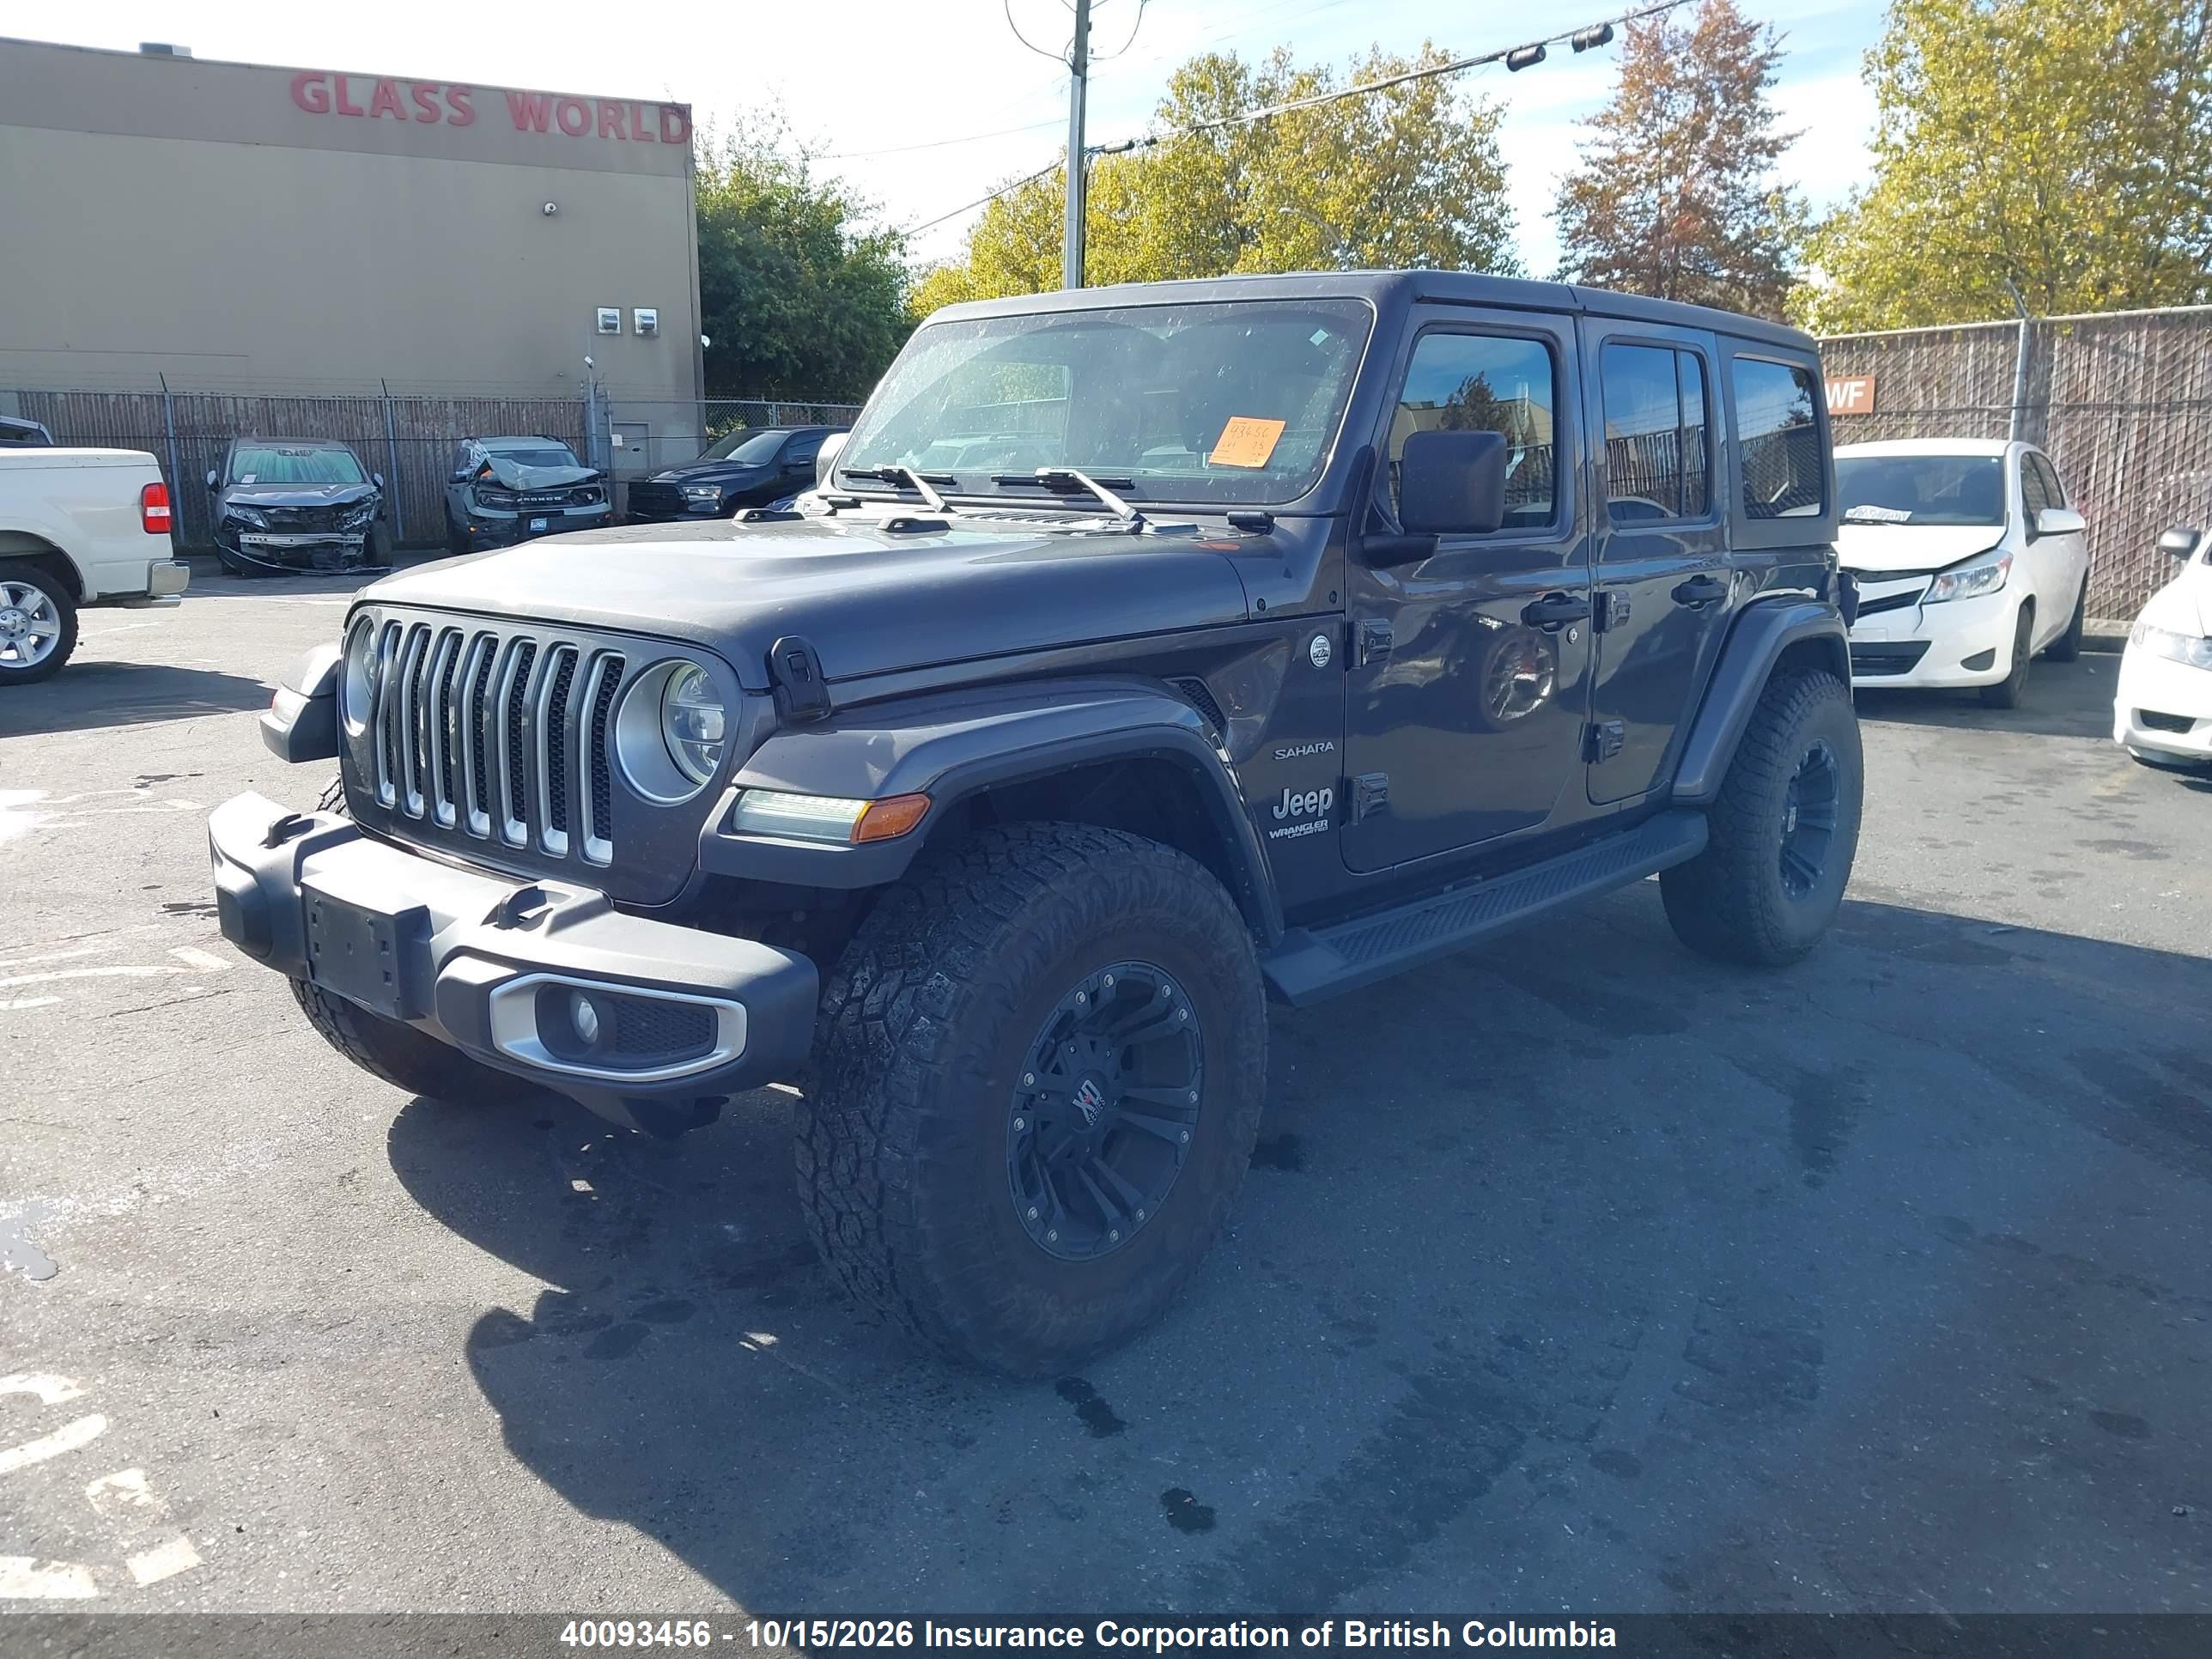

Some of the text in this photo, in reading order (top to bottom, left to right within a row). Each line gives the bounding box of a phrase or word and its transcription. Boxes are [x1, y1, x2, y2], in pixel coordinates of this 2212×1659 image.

[289, 71, 692, 144] GLASS WORLD
[1273, 741, 1335, 760] SAHARA
[1273, 787, 1333, 820] Jeep
[1269, 819, 1328, 839] WRANGLER
[1288, 826, 1328, 839] UNLIMITED
[1086, 1097, 1106, 1126] SERIES
